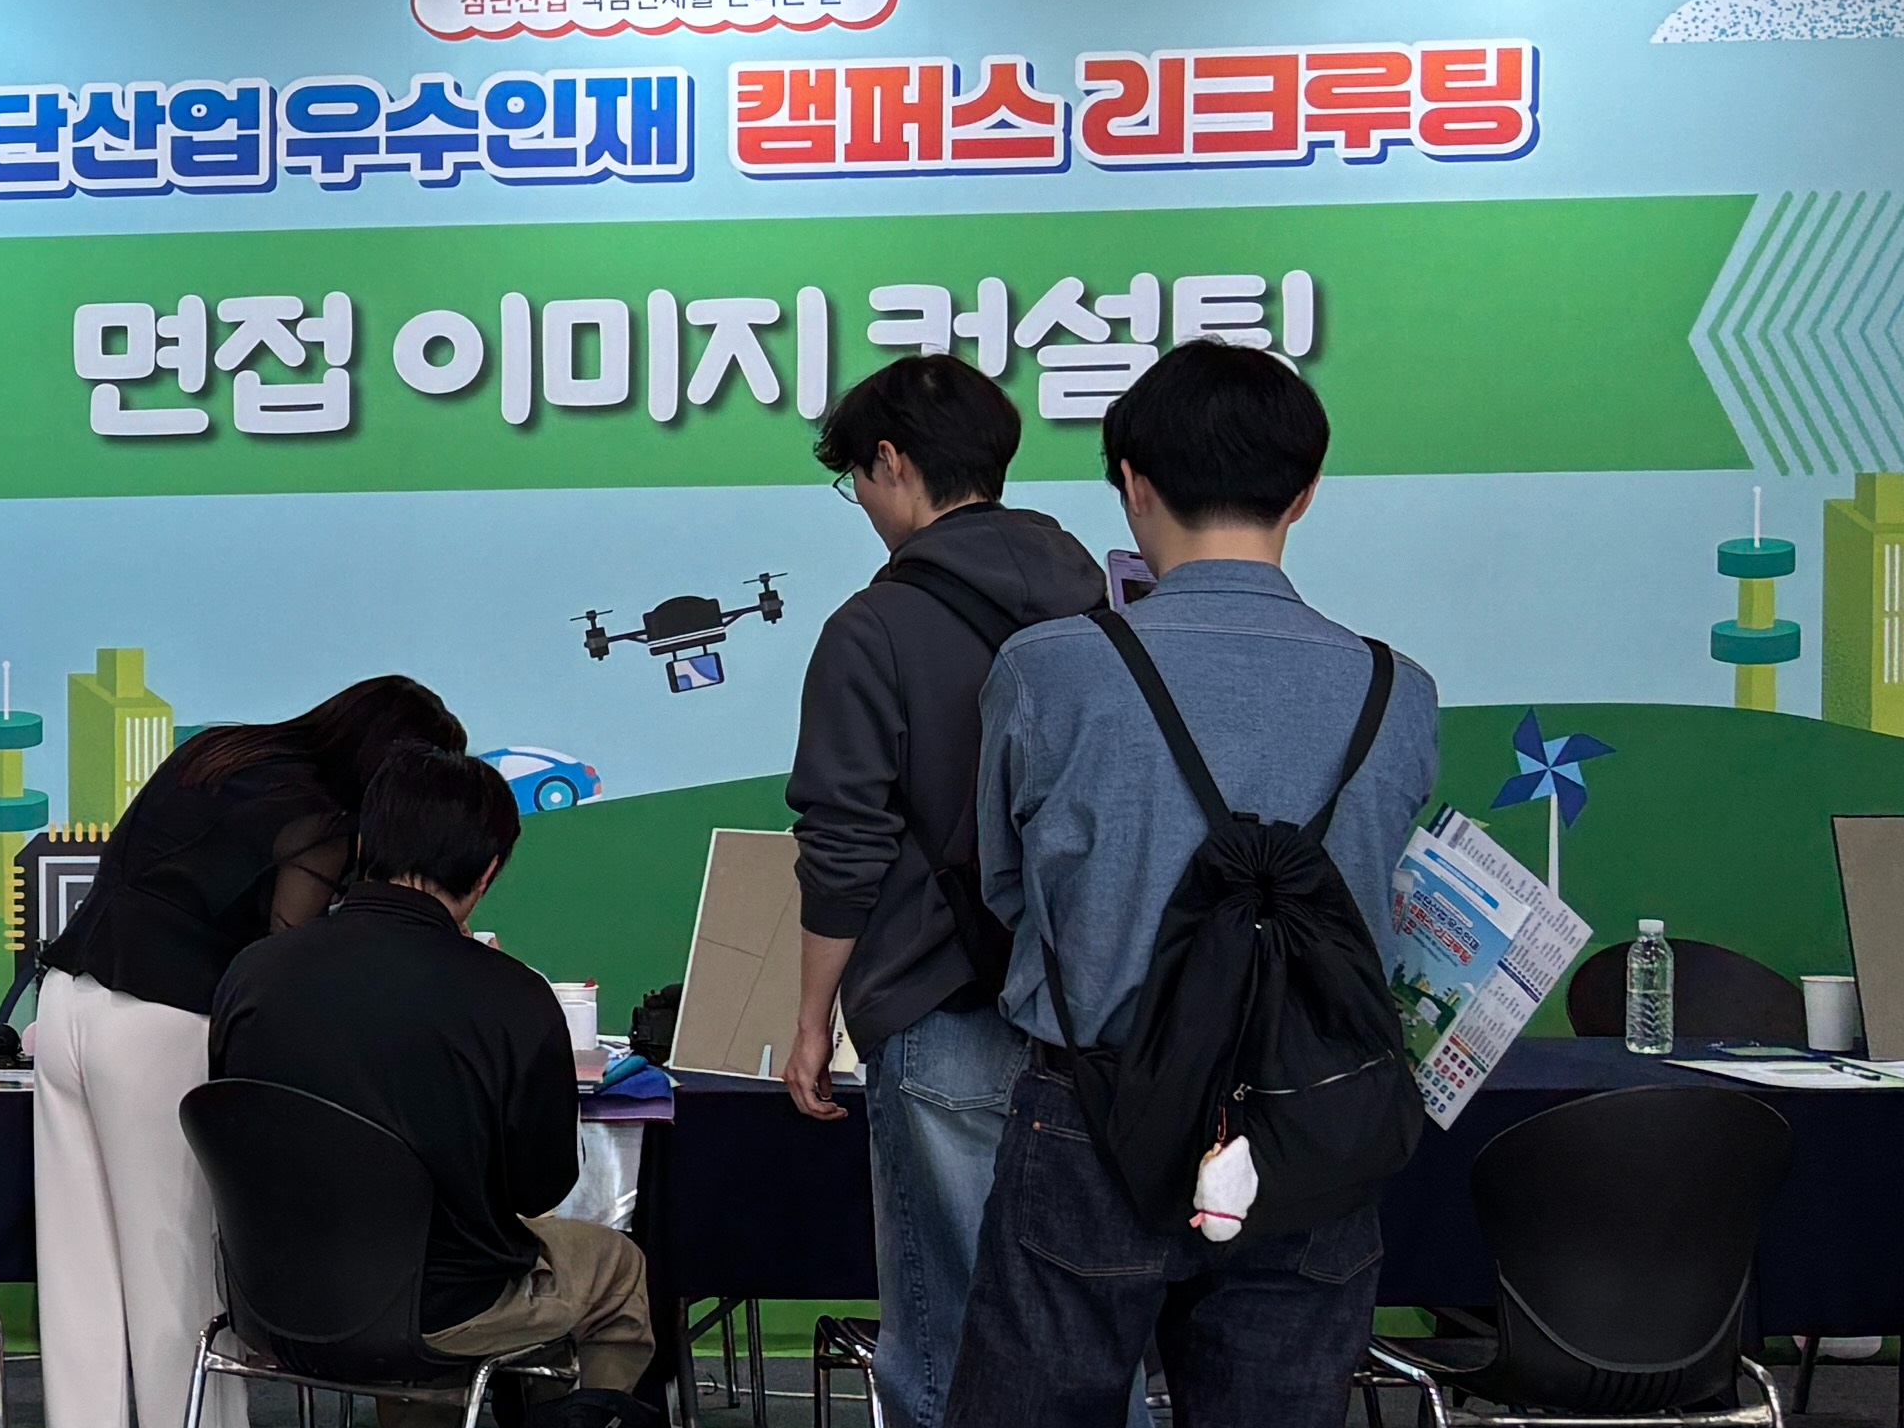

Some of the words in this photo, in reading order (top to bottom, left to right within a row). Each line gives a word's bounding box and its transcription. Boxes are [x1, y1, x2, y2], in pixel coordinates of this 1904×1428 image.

[736, 62, 1057, 165] 캠퍼스
[1080, 47, 1522, 156] 리크루팅
[71, 290, 354, 438] 면접
[392, 285, 829, 425] 이미지
